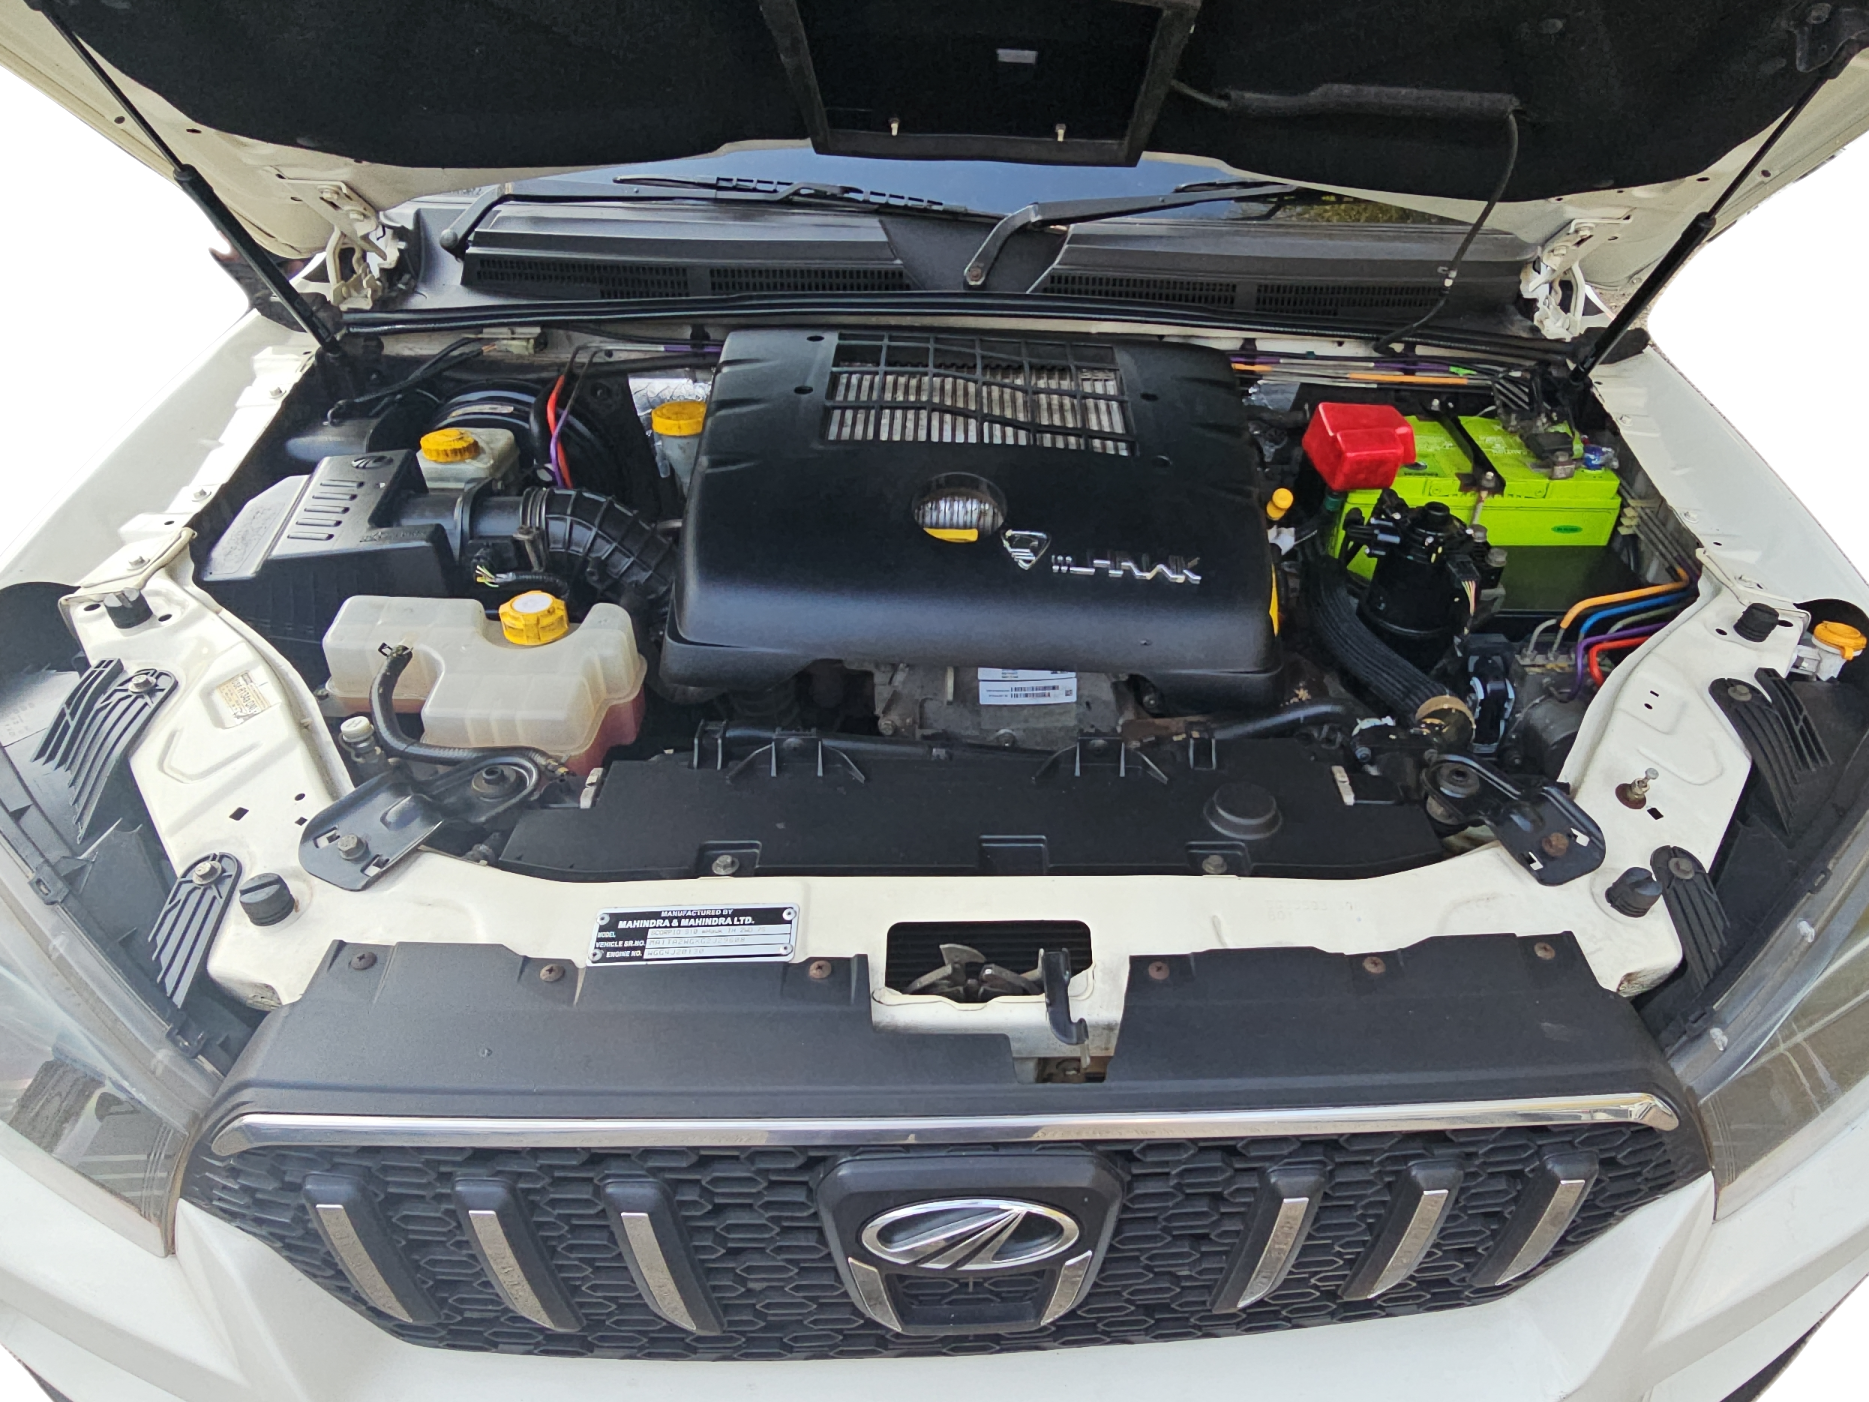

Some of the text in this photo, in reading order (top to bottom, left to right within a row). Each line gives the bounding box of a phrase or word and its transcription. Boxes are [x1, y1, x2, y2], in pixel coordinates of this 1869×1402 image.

[661, 909, 721, 917] MANUFACTURED
[618, 917, 755, 929] MAHINDRA & MAHINDRA LTD.
